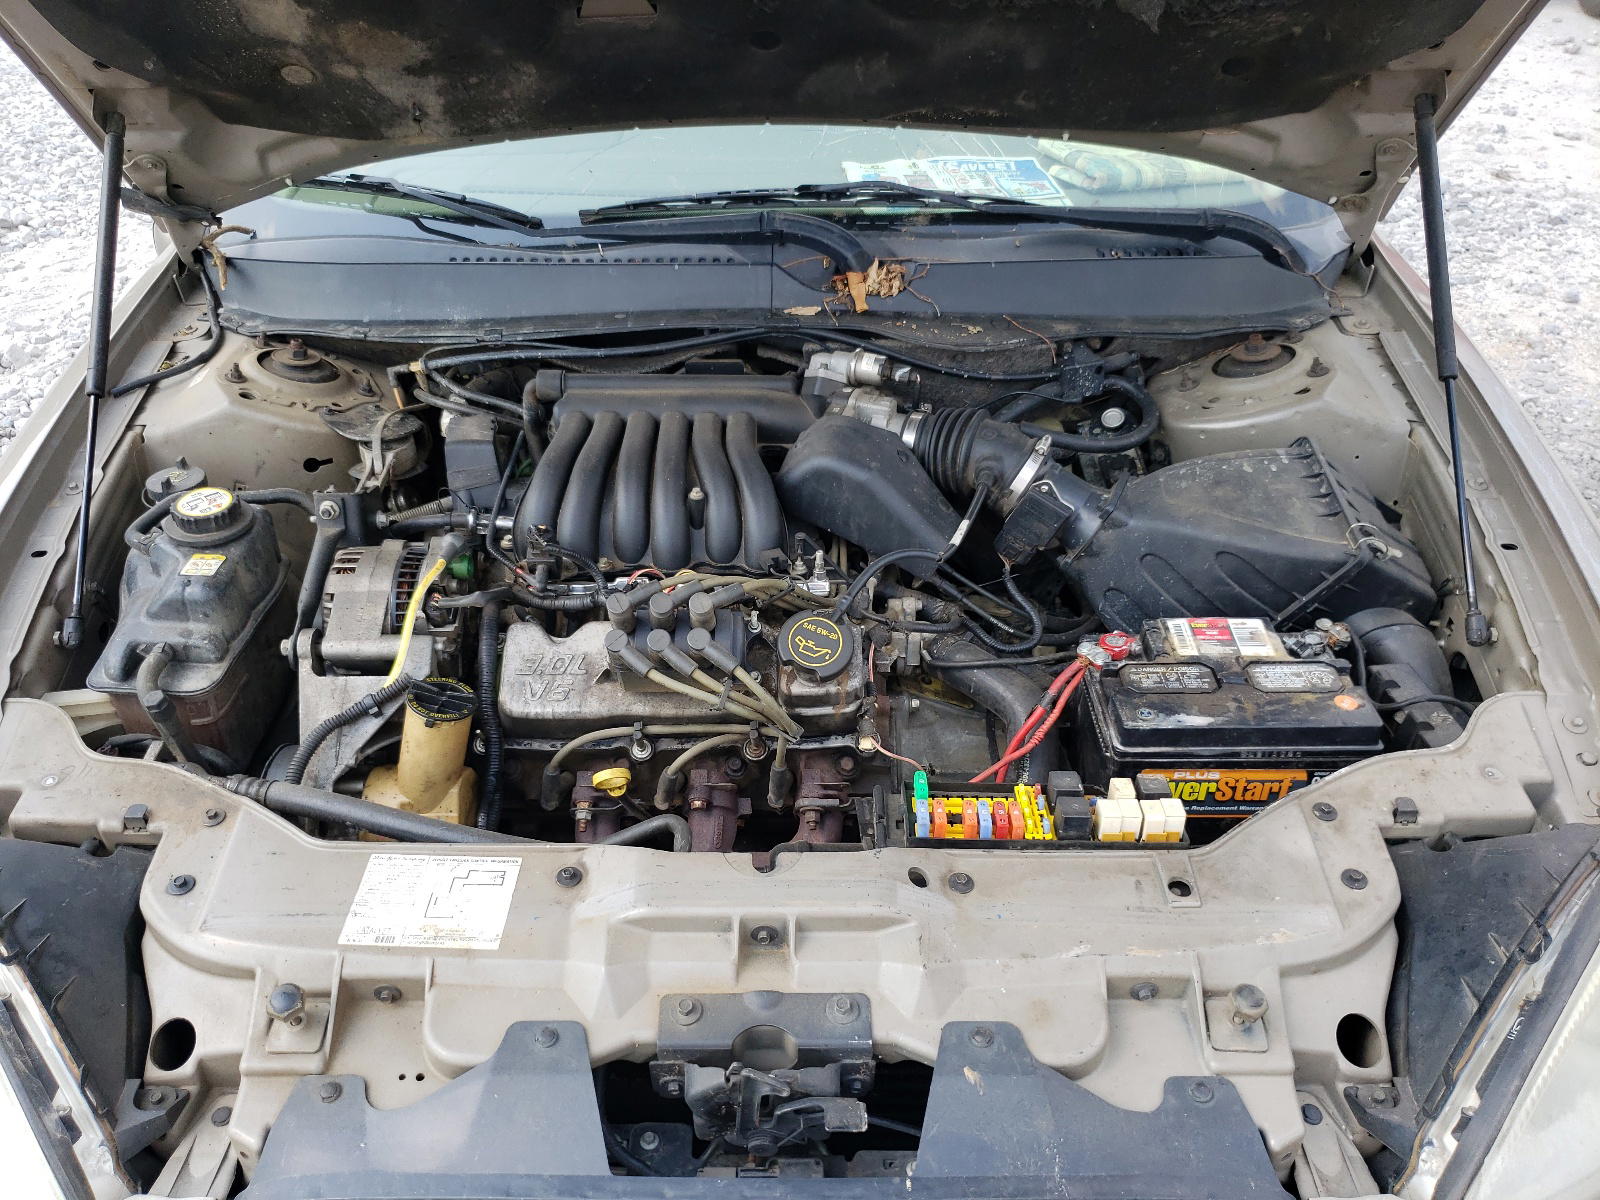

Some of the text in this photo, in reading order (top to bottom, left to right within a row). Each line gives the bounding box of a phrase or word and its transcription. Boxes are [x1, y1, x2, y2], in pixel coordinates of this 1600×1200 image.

[803, 622, 838, 640] SAE 5W-20
[515, 654, 588, 675] 3.0L
[525, 679, 575, 701] V6
[1173, 771, 1221, 779] PLUS
[1167, 777, 1295, 802] verStart
